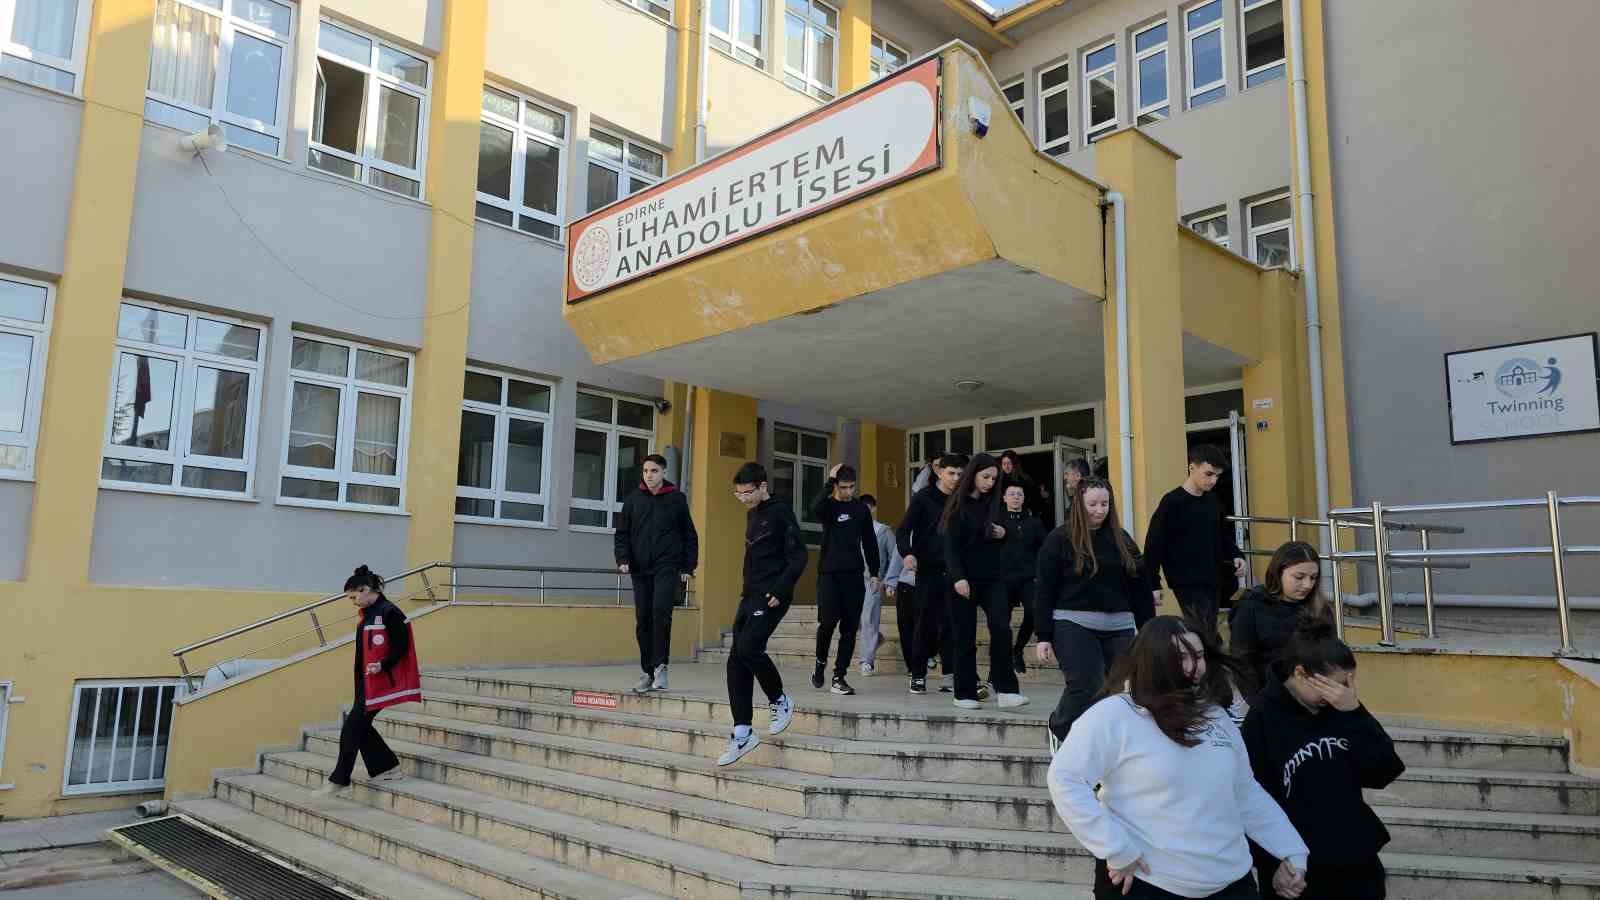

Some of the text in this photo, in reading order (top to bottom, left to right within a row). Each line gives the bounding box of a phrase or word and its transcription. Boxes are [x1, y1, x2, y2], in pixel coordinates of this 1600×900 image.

[616, 201, 762, 278] ANADOLU
[776, 143, 890, 216] LİSESİ
[617, 136, 845, 251] İLHAMİ ERTEM
[1486, 397, 1565, 415] Twinning
